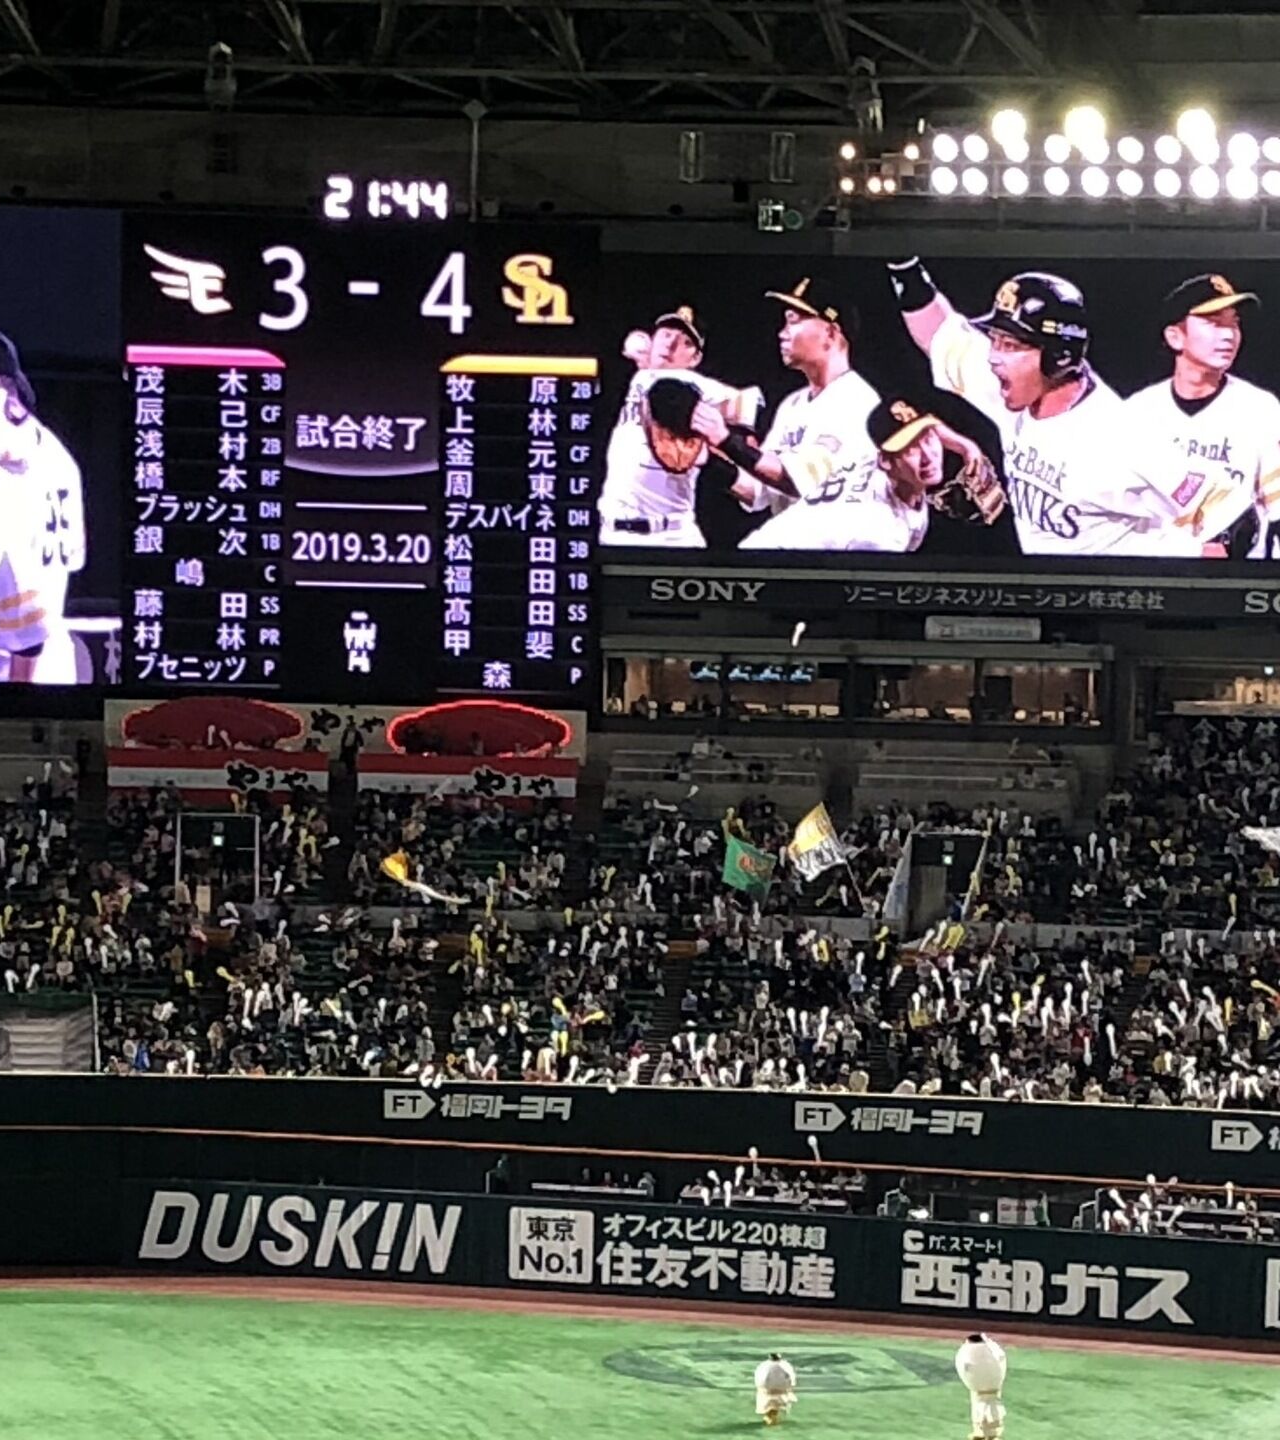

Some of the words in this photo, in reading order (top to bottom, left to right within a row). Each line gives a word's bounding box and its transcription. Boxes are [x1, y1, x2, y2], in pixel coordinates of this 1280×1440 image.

[323, 175, 448, 220] 21:44
[258, 246, 309, 331] 3
[420, 252, 472, 334] 4
[261, 373, 282, 391] 3B
[571, 381, 592, 399] 2B
[261, 405, 281, 423] CF
[571, 413, 591, 430] RF
[296, 414, 427, 451] 試合終了
[261, 437, 282, 455] 2B
[570, 445, 591, 462] CF
[261, 469, 281, 487] RF
[570, 477, 590, 494] LF
[135, 494, 248, 522] ブラッシュ
[259, 501, 281, 518] DH
[445, 502, 556, 532] デスパイネ
[568, 509, 590, 526] DH
[261, 533, 280, 550] 1B
[292, 531, 431, 563] 2019.3.20
[568, 540, 589, 558] 3B
[175, 558, 204, 587] 嶋
[264, 565, 276, 583] C
[568, 573, 589, 590] 1B
[651, 579, 766, 601] SONY
[844, 584, 1165, 611] ソニービジネスソリューション株式会社
[260, 596, 280, 614] SS
[568, 604, 587, 621] SS
[259, 628, 280, 646] PR
[571, 635, 582, 653] C
[135, 652, 246, 681] ブセニッツ
[263, 659, 275, 677] P
[482, 660, 511, 689] 森
[570, 667, 582, 685] P
[440, 1092, 571, 1120] 福岡トヨタ
[851, 1107, 983, 1136] 福岡トヨタ
[526, 1216, 576, 1242] 東京
[603, 1213, 826, 1250] オフィスビル220棟超
[520, 1246, 584, 1275] No.1
[596, 1241, 835, 1299] 住友不動産
[901, 1253, 1194, 1325] 西部ガス
